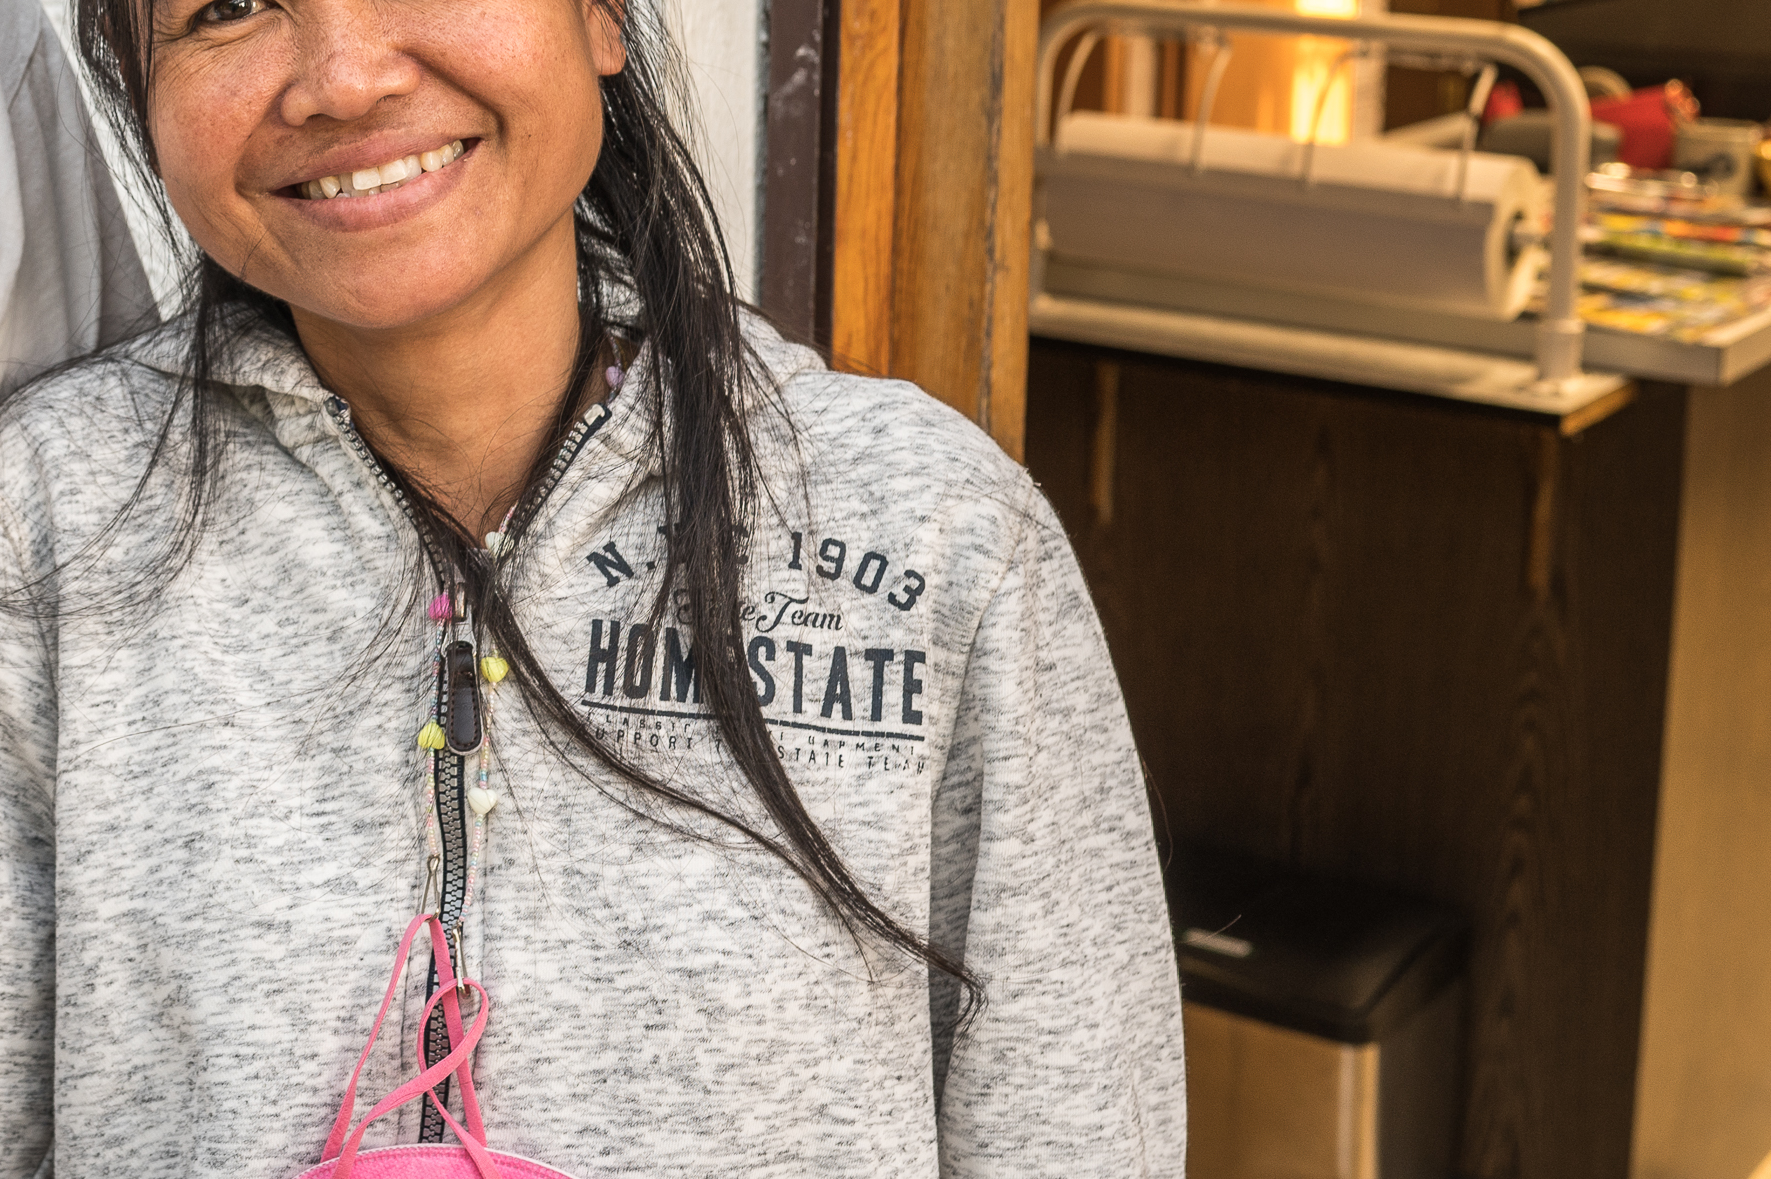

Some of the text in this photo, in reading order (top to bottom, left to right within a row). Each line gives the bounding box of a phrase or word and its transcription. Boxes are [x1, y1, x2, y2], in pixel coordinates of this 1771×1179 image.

[755, 590, 844, 633] Team
[787, 531, 926, 612] 1903
[584, 618, 927, 726] HOMSTATE
